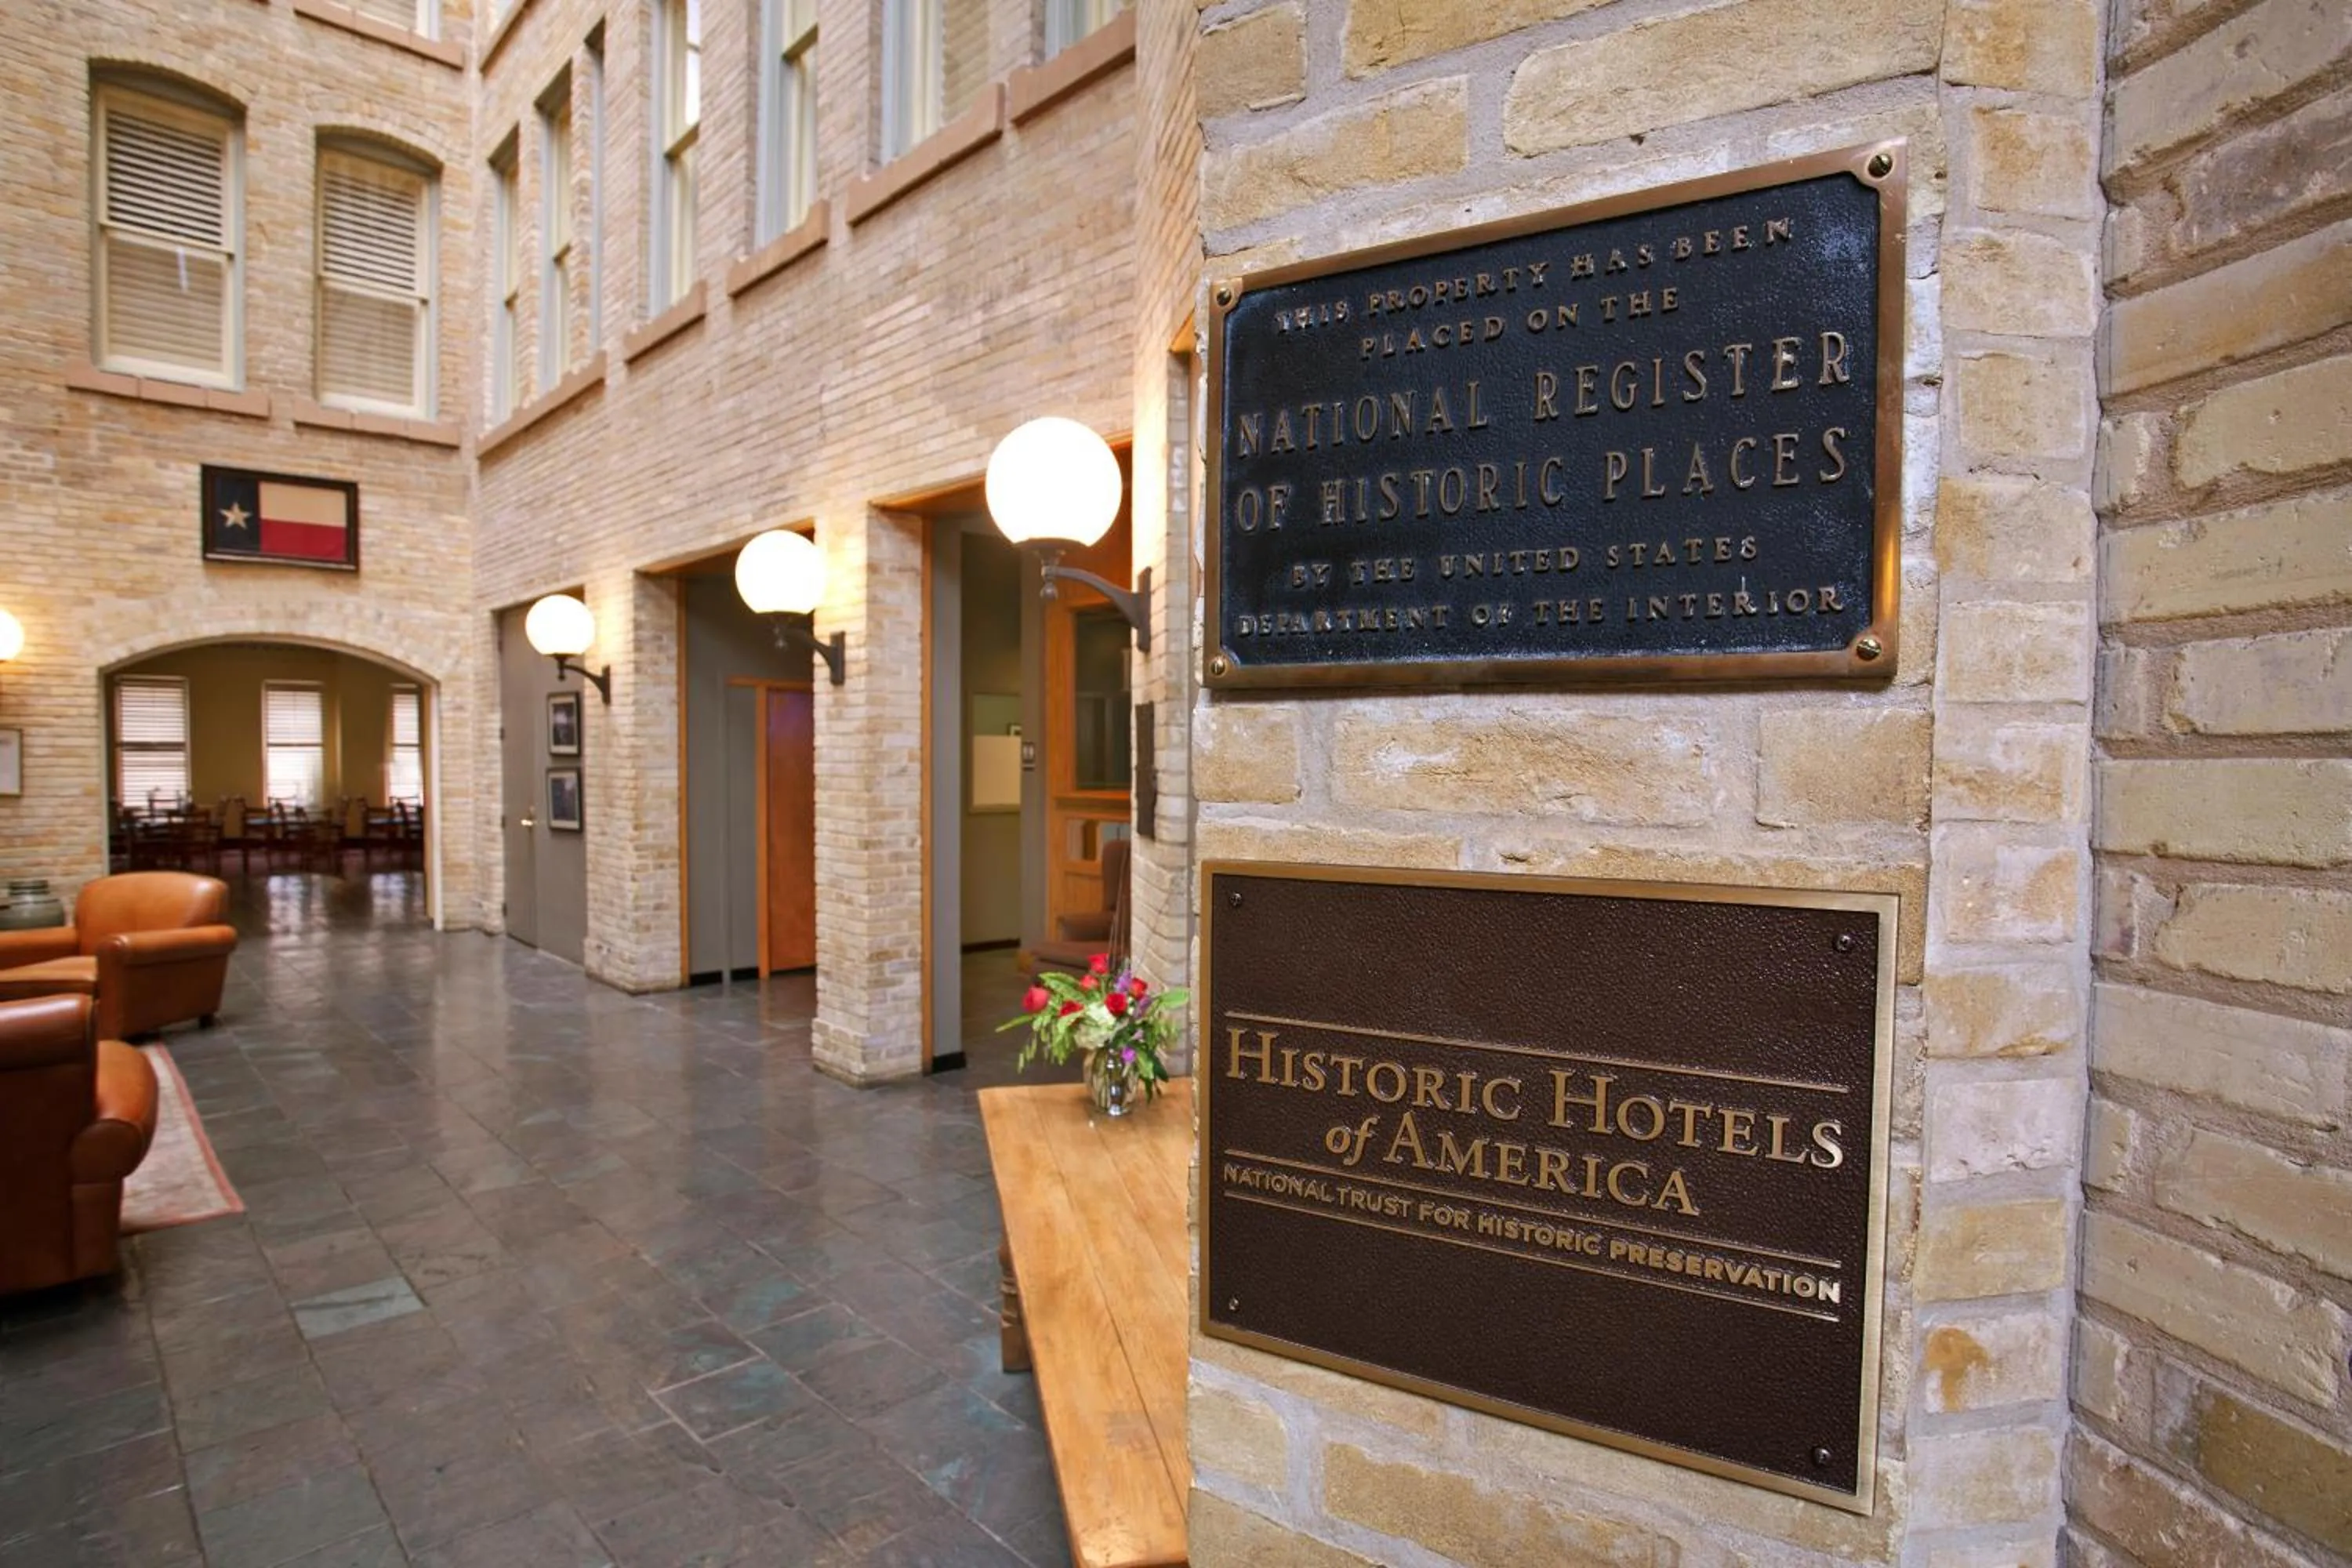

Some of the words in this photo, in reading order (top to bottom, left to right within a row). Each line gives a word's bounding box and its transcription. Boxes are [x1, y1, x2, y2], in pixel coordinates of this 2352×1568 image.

[1274, 299, 1349, 334] THIS
[1368, 261, 1550, 314] PROPERTY
[1571, 244, 1655, 280] HAS
[1675, 217, 1794, 261] BEEN
[1360, 315, 1504, 360] PLACED
[1527, 304, 1581, 332] ON
[1602, 286, 1680, 321] THE
[1237, 380, 1489, 459] NATIONAL
[1534, 331, 1851, 421] REGISTER
[1236, 484, 1291, 534] OF
[1319, 456, 1565, 527] HISTORIC
[1604, 426, 1848, 501] PLACES
[1240, 604, 1452, 637] DEPARTMENT
[1472, 604, 1513, 626] OF
[1535, 597, 1605, 624] THE
[1627, 586, 1846, 620] INTERIOR
[1291, 563, 1331, 589] BY
[1352, 557, 1414, 585] THE
[1441, 546, 1581, 578] UNITED
[1606, 535, 1759, 568] STATES
[1225, 1026, 1523, 1121] HISTORIC
[1548, 1069, 1844, 1170] HOTELS
[1325, 1116, 1379, 1165] of
[1382, 1110, 1701, 1218] AMERICA
[1224, 1163, 1334, 1203] NATIONAL
[1336, 1184, 1412, 1218] TRUST
[1418, 1200, 1471, 1232] FOR
[1477, 1213, 1601, 1258] HISTORIC
[1610, 1240, 1842, 1306] PRESERVATION
